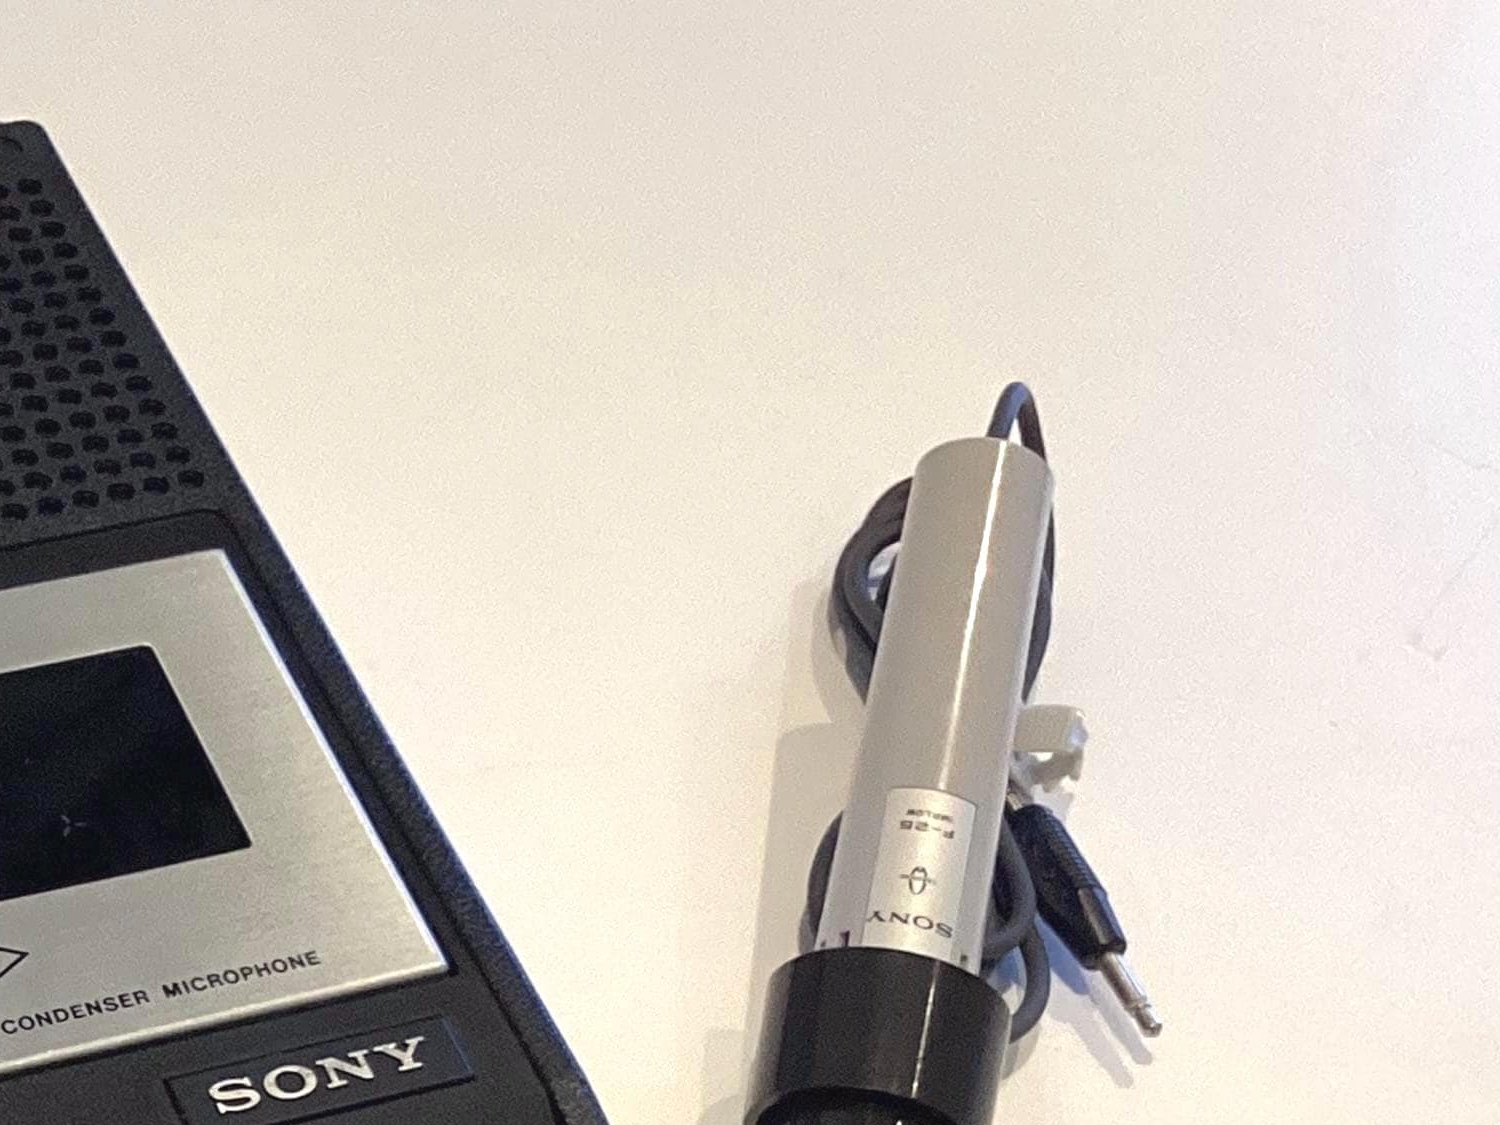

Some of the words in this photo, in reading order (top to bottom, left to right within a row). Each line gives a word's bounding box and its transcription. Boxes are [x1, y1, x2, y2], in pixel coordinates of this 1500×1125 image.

[867, 910, 953, 938] SONY
[1, 989, 150, 1036] CONDENSER
[162, 950, 322, 999] MICROPHONE
[208, 1036, 425, 1115] SONY
